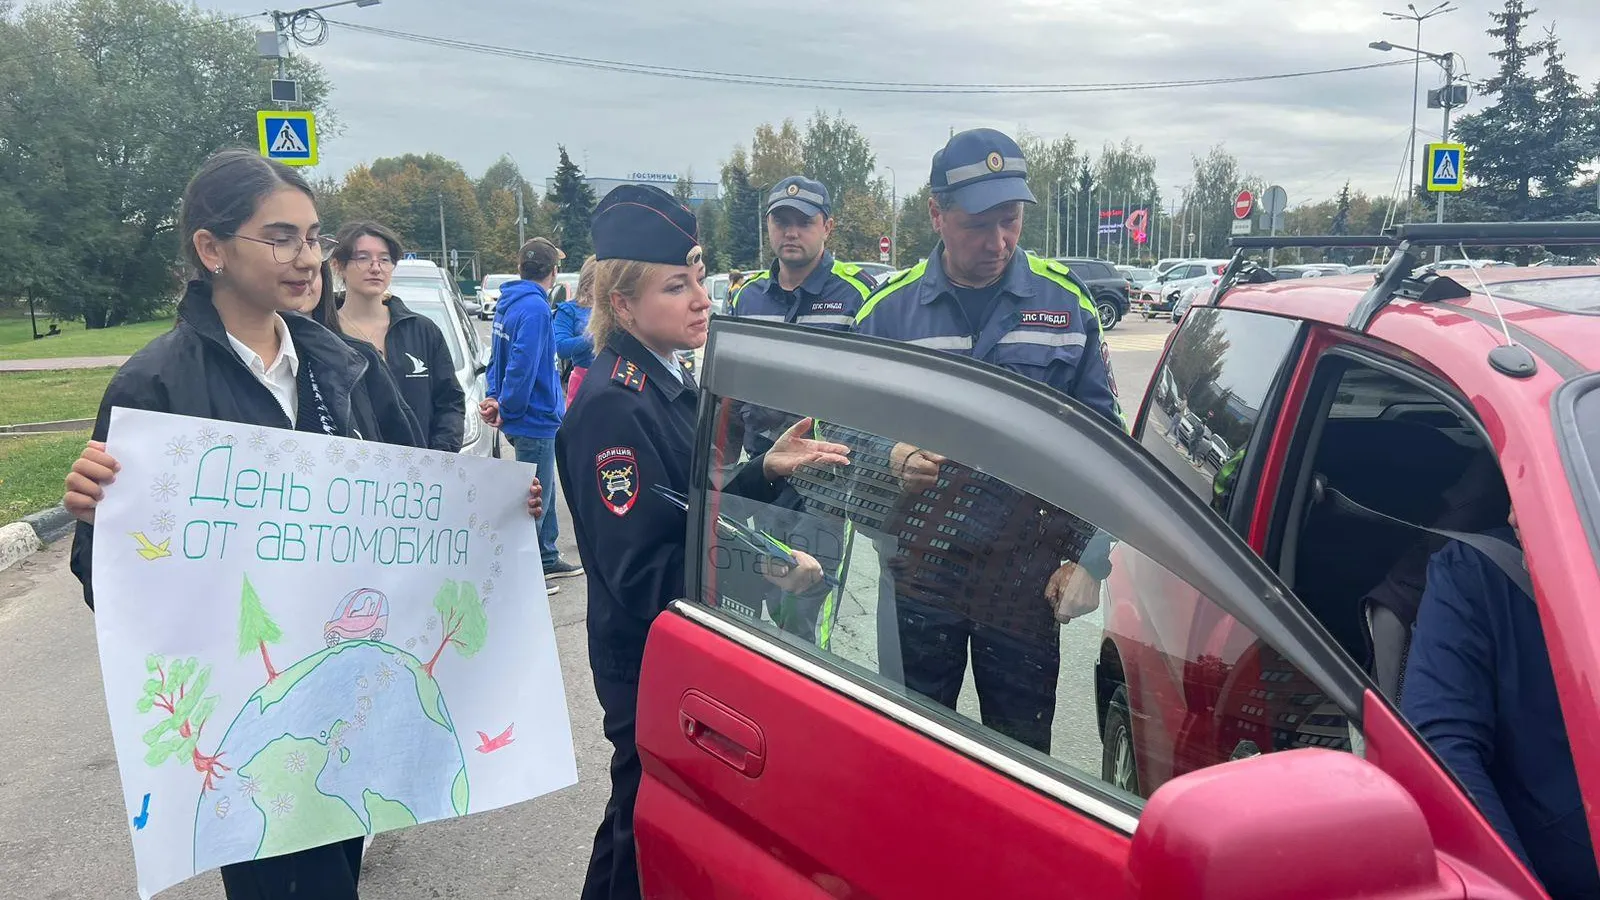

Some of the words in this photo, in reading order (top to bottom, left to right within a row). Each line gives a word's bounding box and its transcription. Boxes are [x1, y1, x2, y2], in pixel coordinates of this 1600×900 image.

[632, 172, 678, 180] ГОСТИНИЦА
[1039, 313, 1066, 324] ГИБДД
[598, 448, 632, 462] ПОЛИЦИЯ
[189, 445, 311, 512] День
[327, 477, 443, 521] отказа
[183, 520, 238, 559] от
[256, 521, 469, 565] автомобиля
